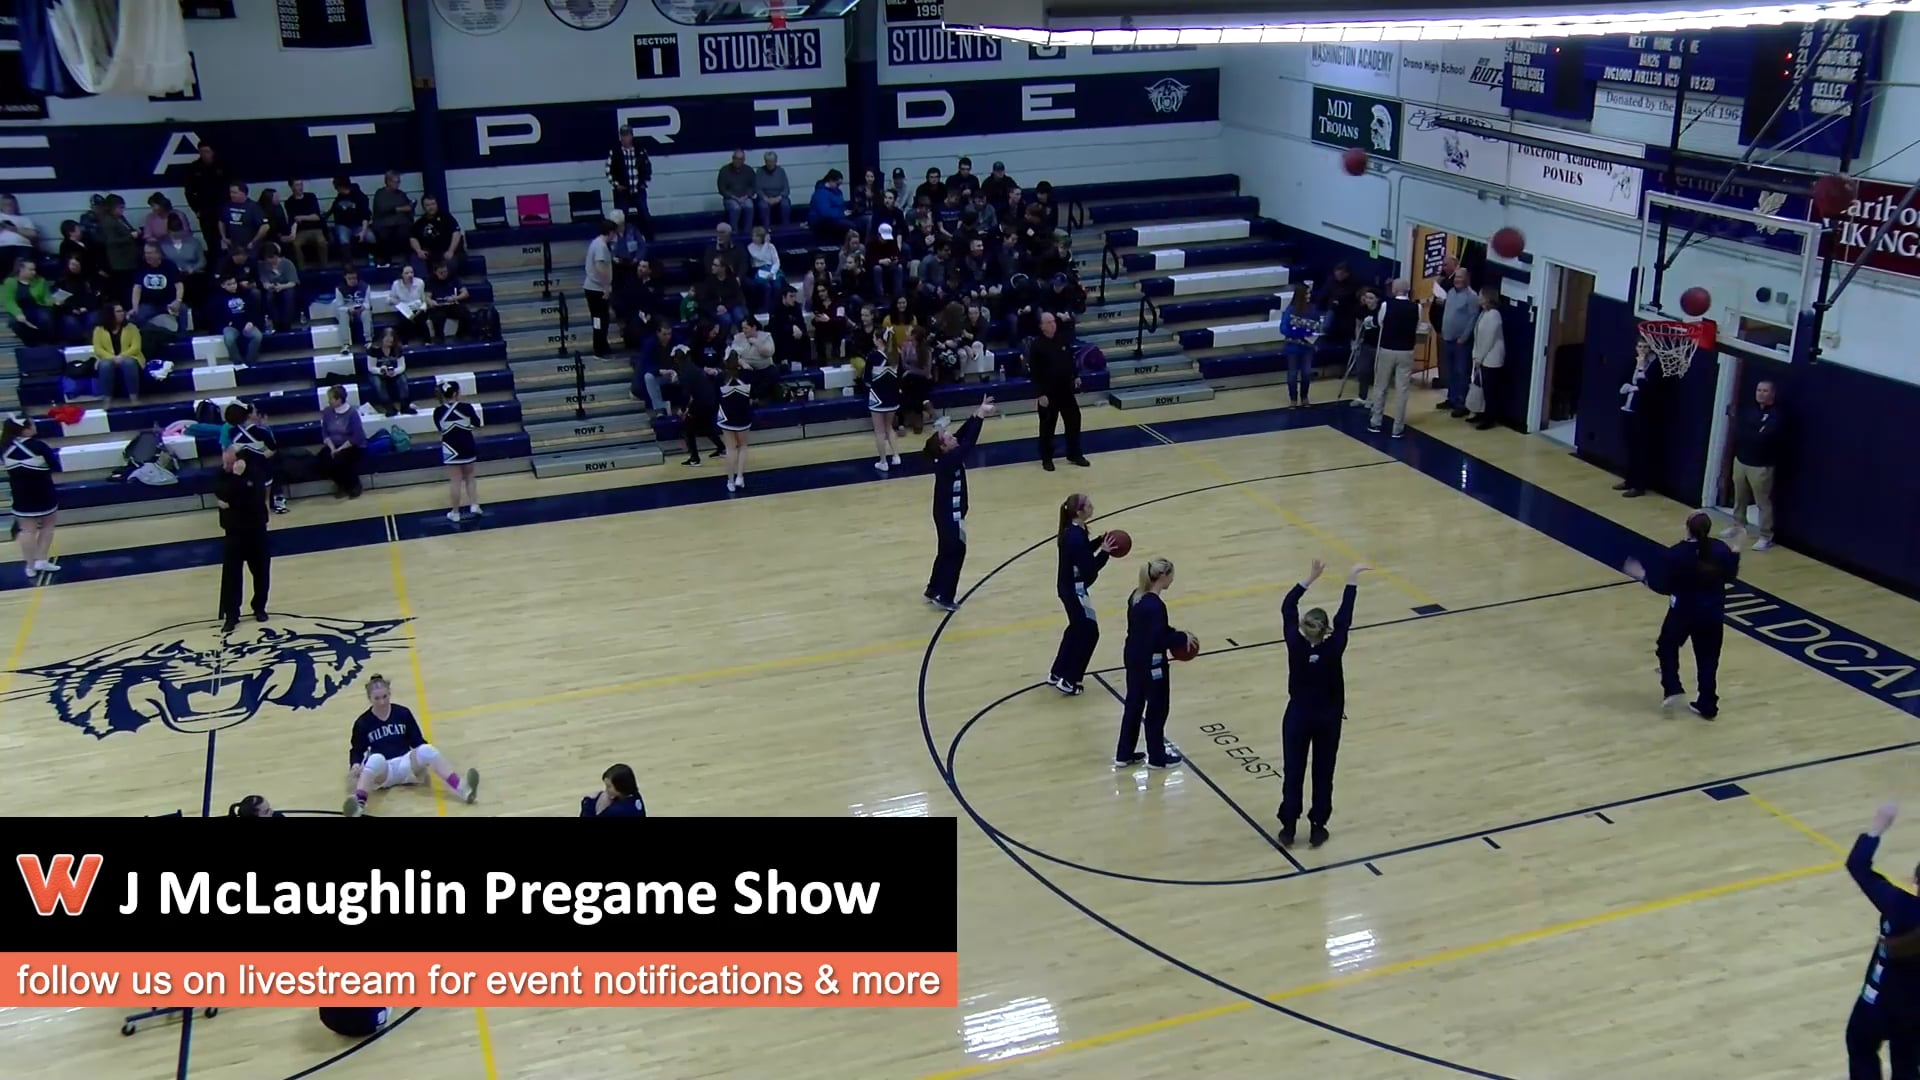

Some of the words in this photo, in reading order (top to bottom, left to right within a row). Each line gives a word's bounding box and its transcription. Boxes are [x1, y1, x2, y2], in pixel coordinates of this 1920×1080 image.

[636, 36, 676, 46] SECTION
[704, 31, 816, 71] STUDENTS
[1312, 43, 1356, 67] WASHINGTON
[1358, 48, 1395, 73] ACADEMY
[1424, 60, 1440, 74] High
[1441, 60, 1466, 76] School
[1606, 91, 1642, 109] Donated
[1645, 98, 1657, 112] by
[1658, 99, 1675, 112] the
[1327, 98, 1353, 120] MDI
[1543, 165, 1584, 186] PONIES
[522, 246, 541, 255] ROW
[1098, 311, 1116, 320] ROW
[1115, 337, 1133, 346] ROW
[1134, 366, 1153, 375] ROW
[1155, 397, 1175, 405] ROW
[574, 426, 596, 436] ROW
[599, 425, 605, 433] 2
[585, 462, 608, 472] ROW
[1199, 722, 1240, 746] BIG
[1225, 746, 1282, 780] EAST
